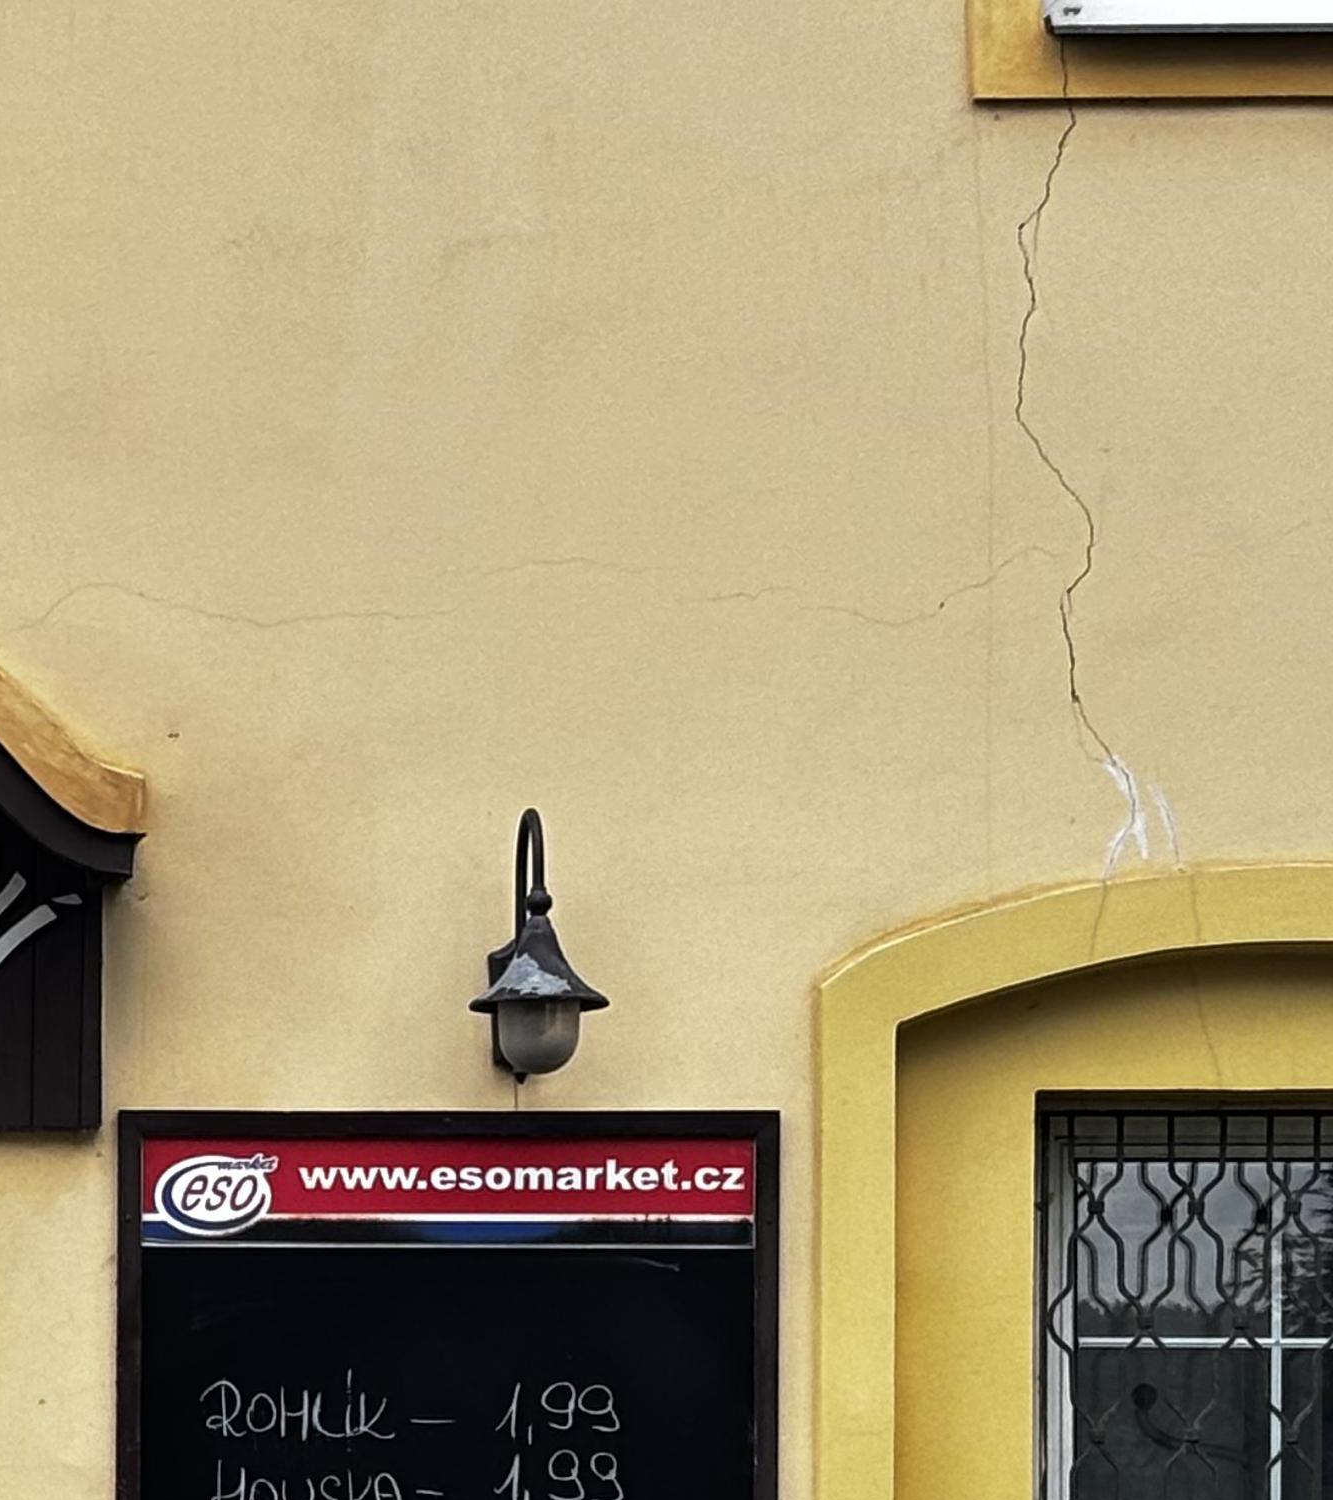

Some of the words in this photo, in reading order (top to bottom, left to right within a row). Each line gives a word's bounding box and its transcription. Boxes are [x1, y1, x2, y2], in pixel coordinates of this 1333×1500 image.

[181, 1174, 259, 1211] eso
[298, 1158, 745, 1191] www.esomarket.cz
[200, 1368, 395, 1441] ROHLÍK
